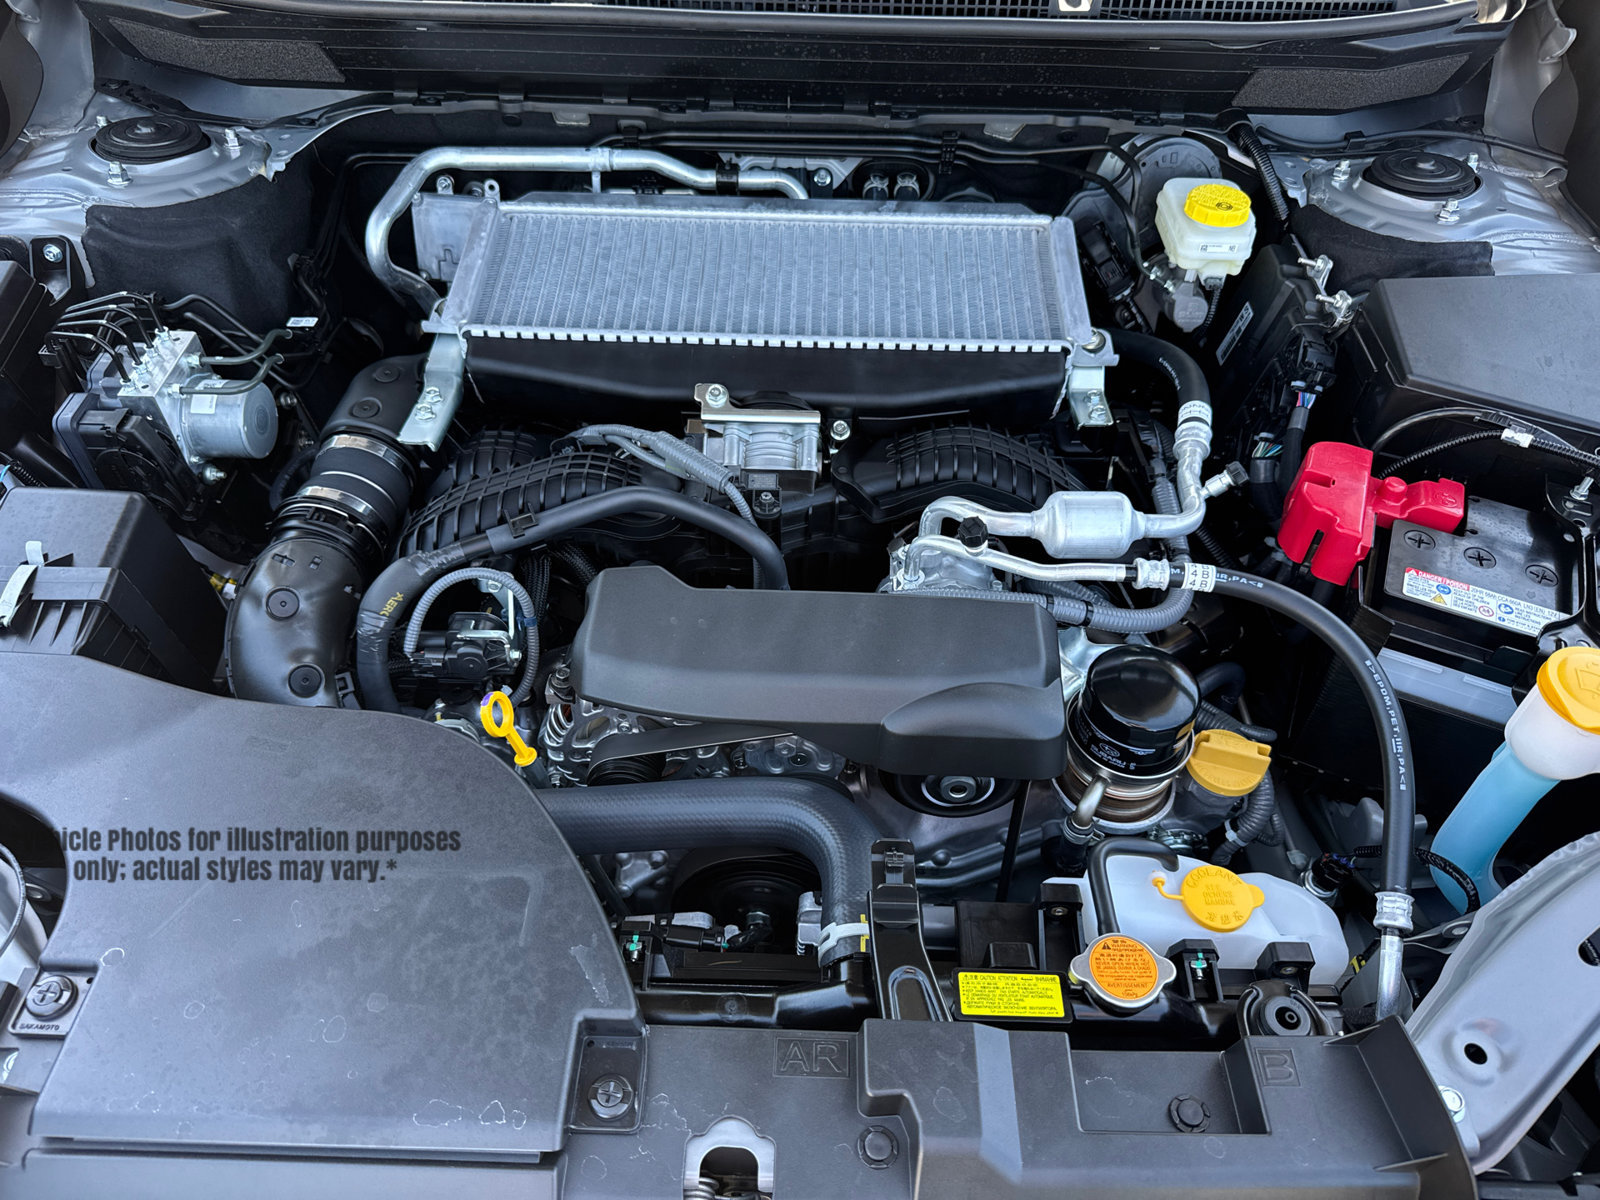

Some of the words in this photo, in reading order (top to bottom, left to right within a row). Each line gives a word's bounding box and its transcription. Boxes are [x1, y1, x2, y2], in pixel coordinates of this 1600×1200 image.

[1189, 579, 1196, 587] 4
[1199, 580, 1208, 589] B
[1191, 569, 1198, 578] 4
[1201, 570, 1210, 579] B
[1419, 571, 1441, 584] DANGER
[1445, 578, 1468, 591] POISON
[1498, 595, 1509, 603] CCA
[1185, 868, 1242, 888] COOLANT
[780, 1040, 842, 1073] AR
[1260, 1052, 1295, 1083] B
